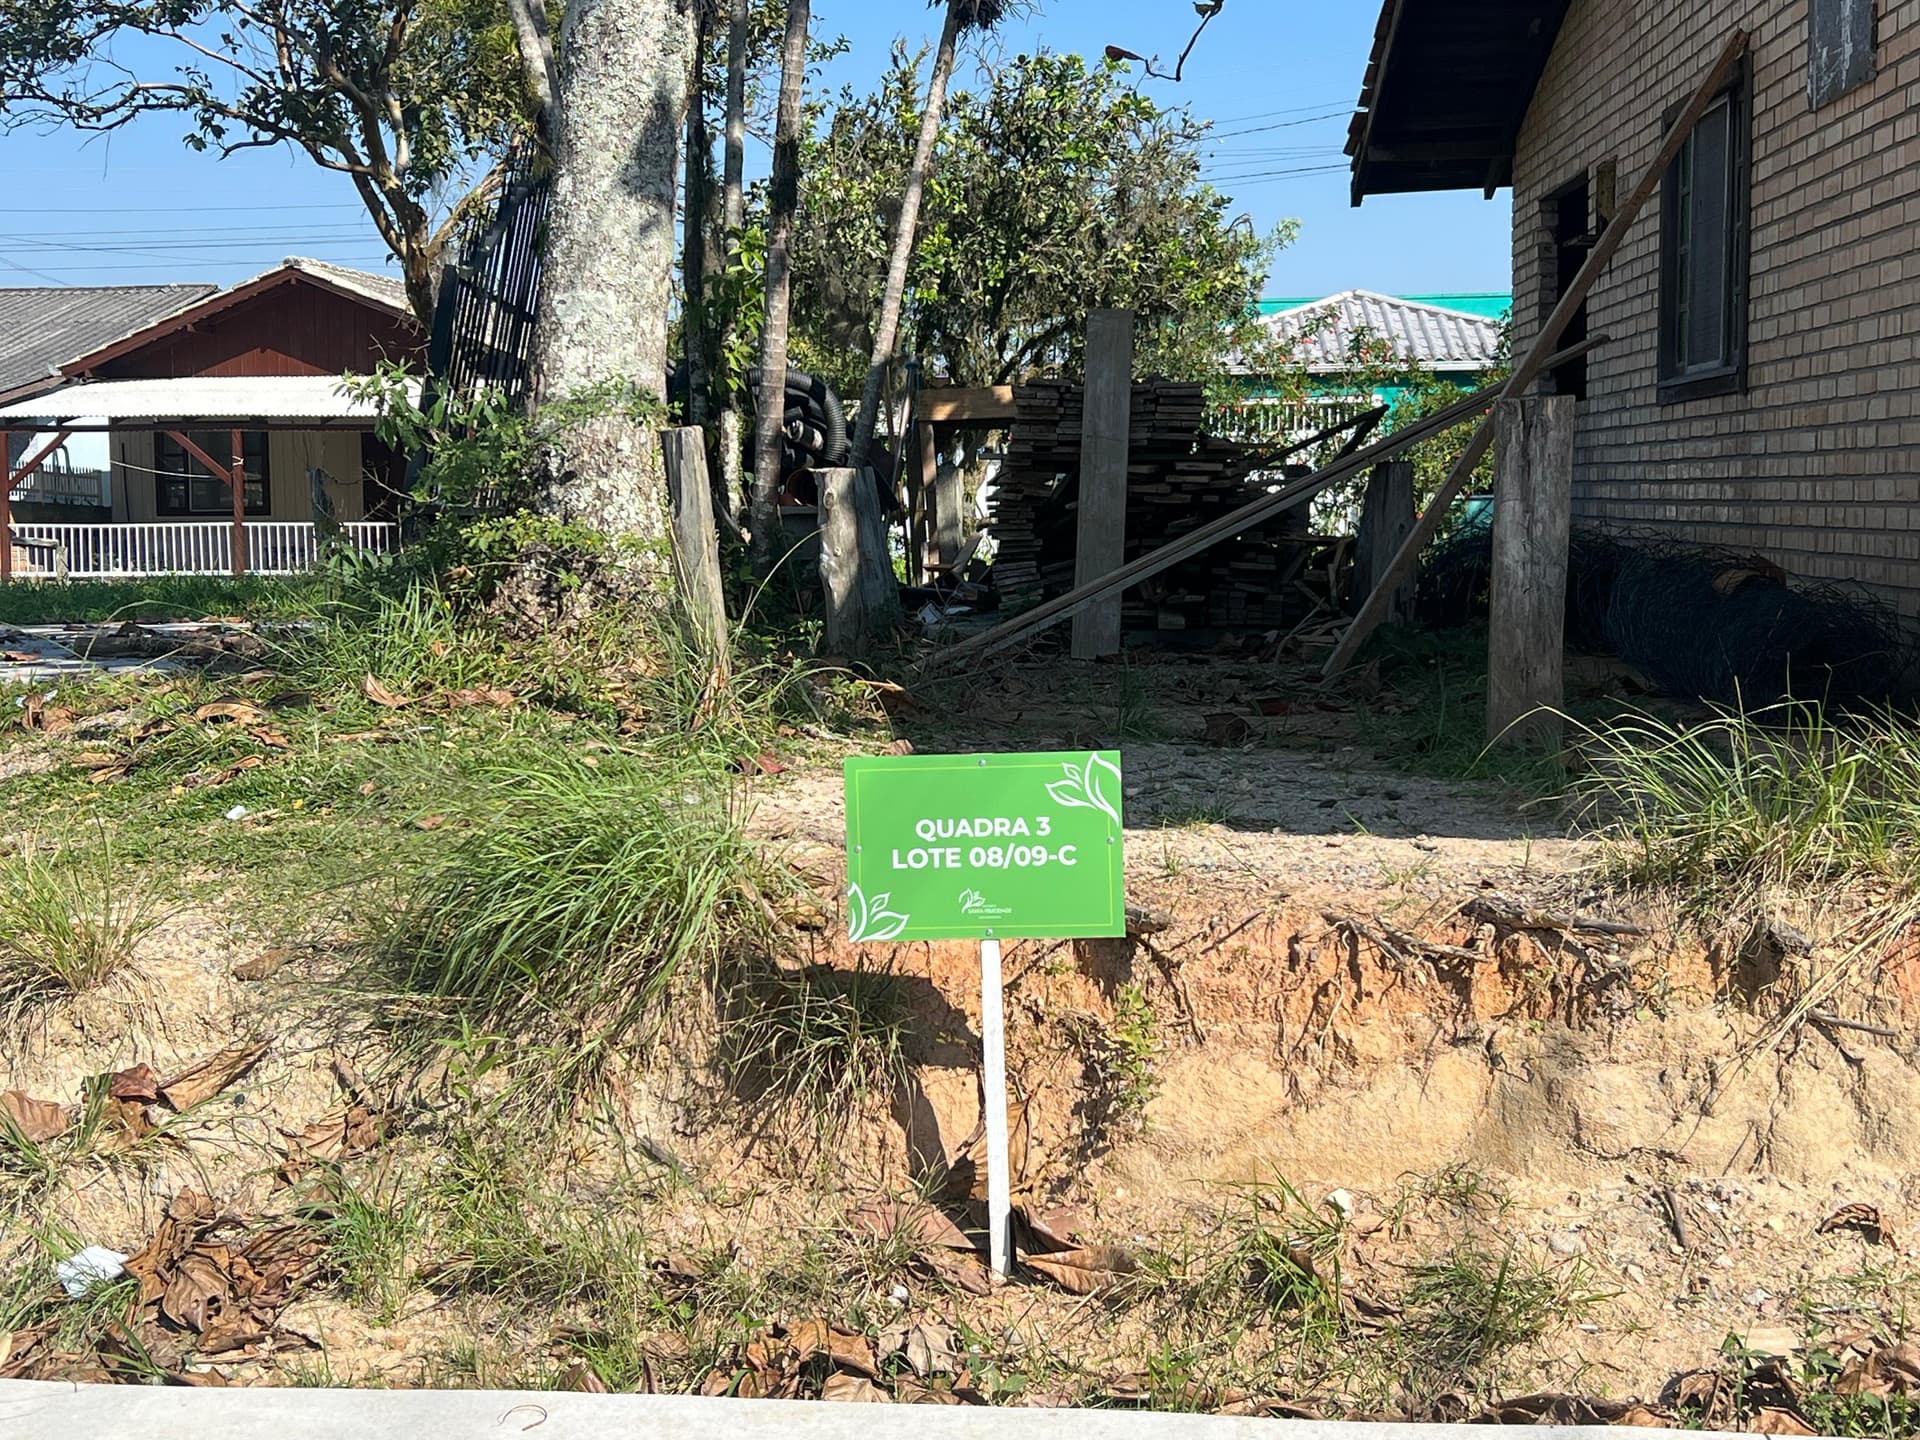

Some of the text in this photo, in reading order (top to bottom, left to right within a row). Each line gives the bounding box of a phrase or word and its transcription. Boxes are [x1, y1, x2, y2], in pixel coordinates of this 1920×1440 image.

[915, 816, 1052, 842] QUADRA 3
[892, 843, 1078, 869] LOTE 08/09-C
